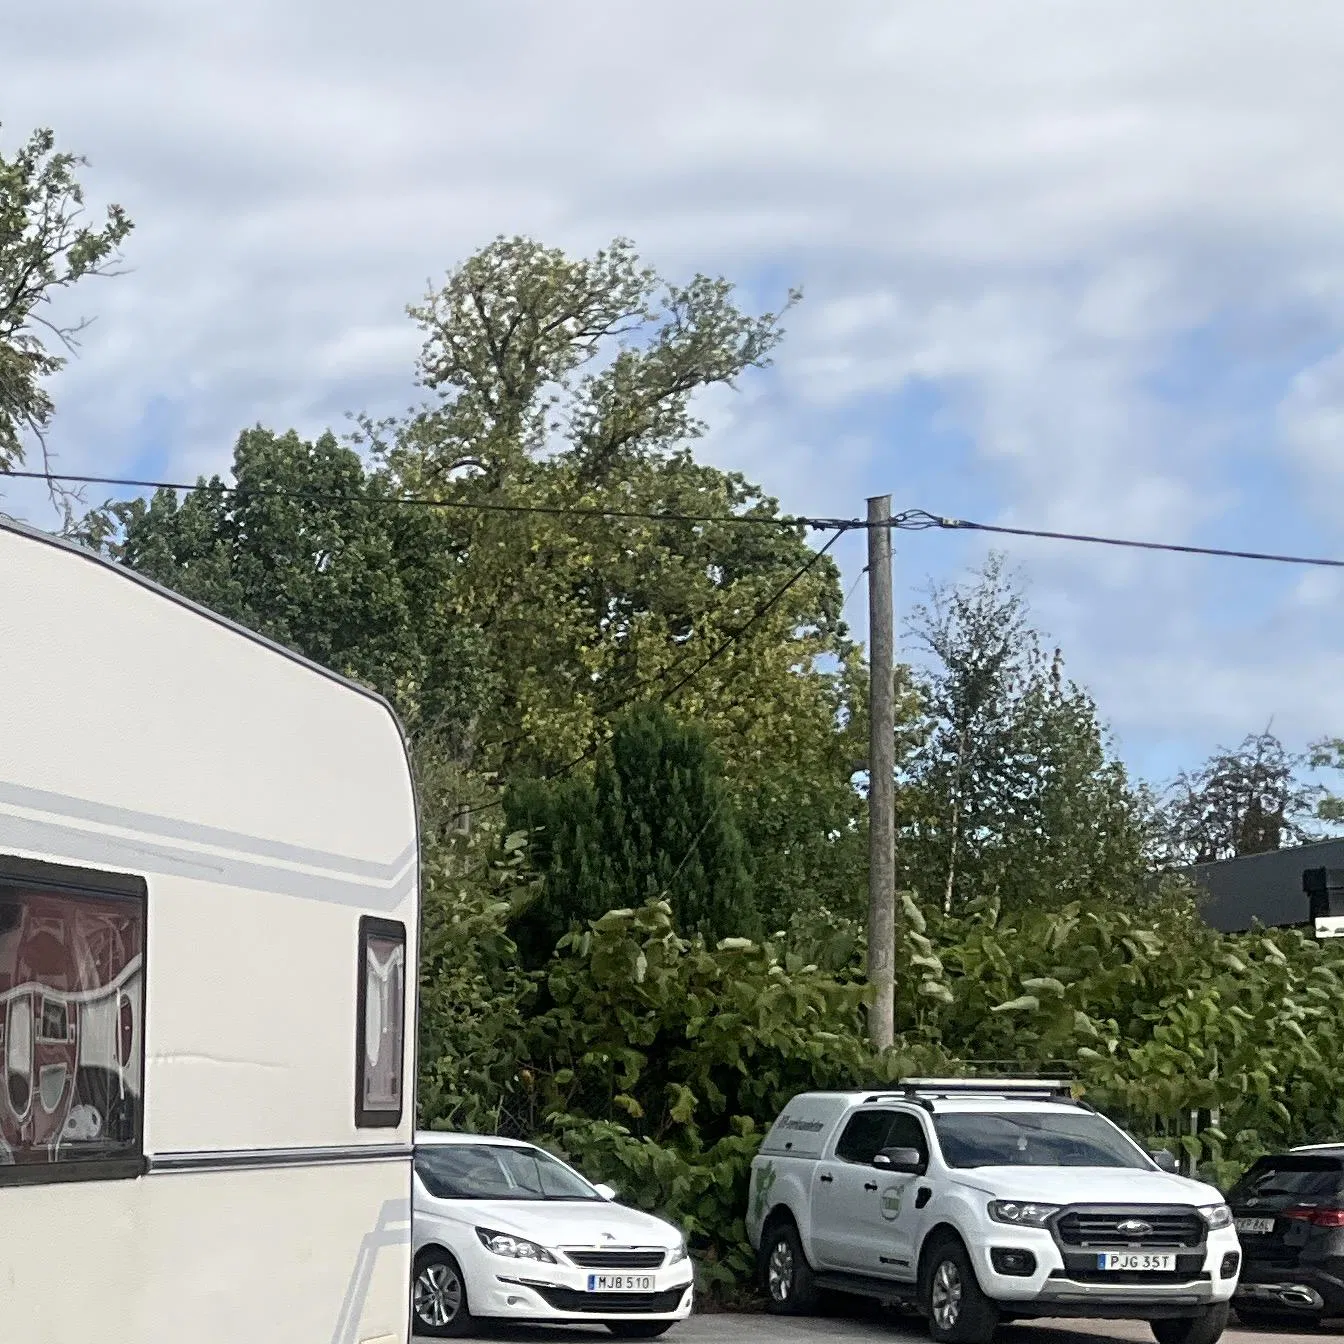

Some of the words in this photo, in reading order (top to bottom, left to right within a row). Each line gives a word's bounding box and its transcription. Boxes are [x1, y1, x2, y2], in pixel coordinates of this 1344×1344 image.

[1110, 1255, 1138, 1268] PJG
[1142, 1255, 1169, 1268] 35T
[626, 1276, 650, 1289] 510
